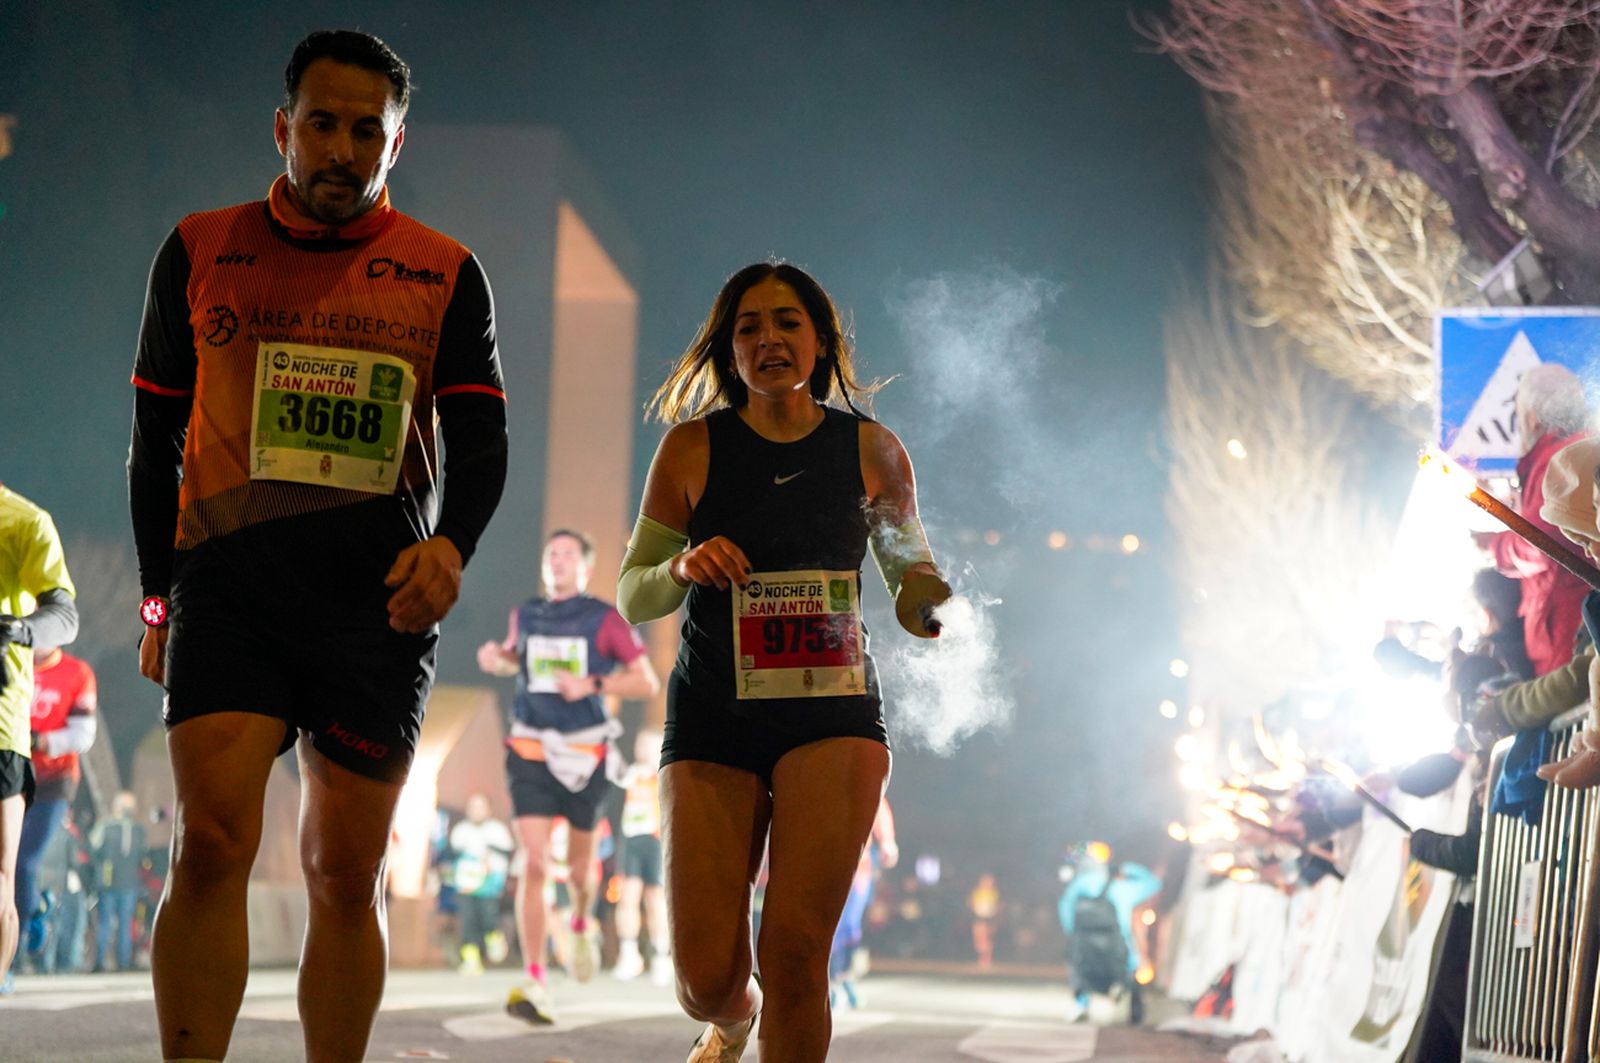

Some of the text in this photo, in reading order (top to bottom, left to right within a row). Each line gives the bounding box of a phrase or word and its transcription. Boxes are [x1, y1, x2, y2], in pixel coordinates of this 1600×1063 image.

[248, 305, 438, 348] ÁREA DE DEPORTE
[291, 360, 359, 380] NOCHE DE
[271, 373, 303, 391] SAN
[305, 377, 356, 397] ANTÓN
[277, 393, 384, 445] 3668
[764, 584, 823, 599] NOCHE DE
[749, 601, 776, 616] SAN
[779, 597, 824, 614] ANTÓN
